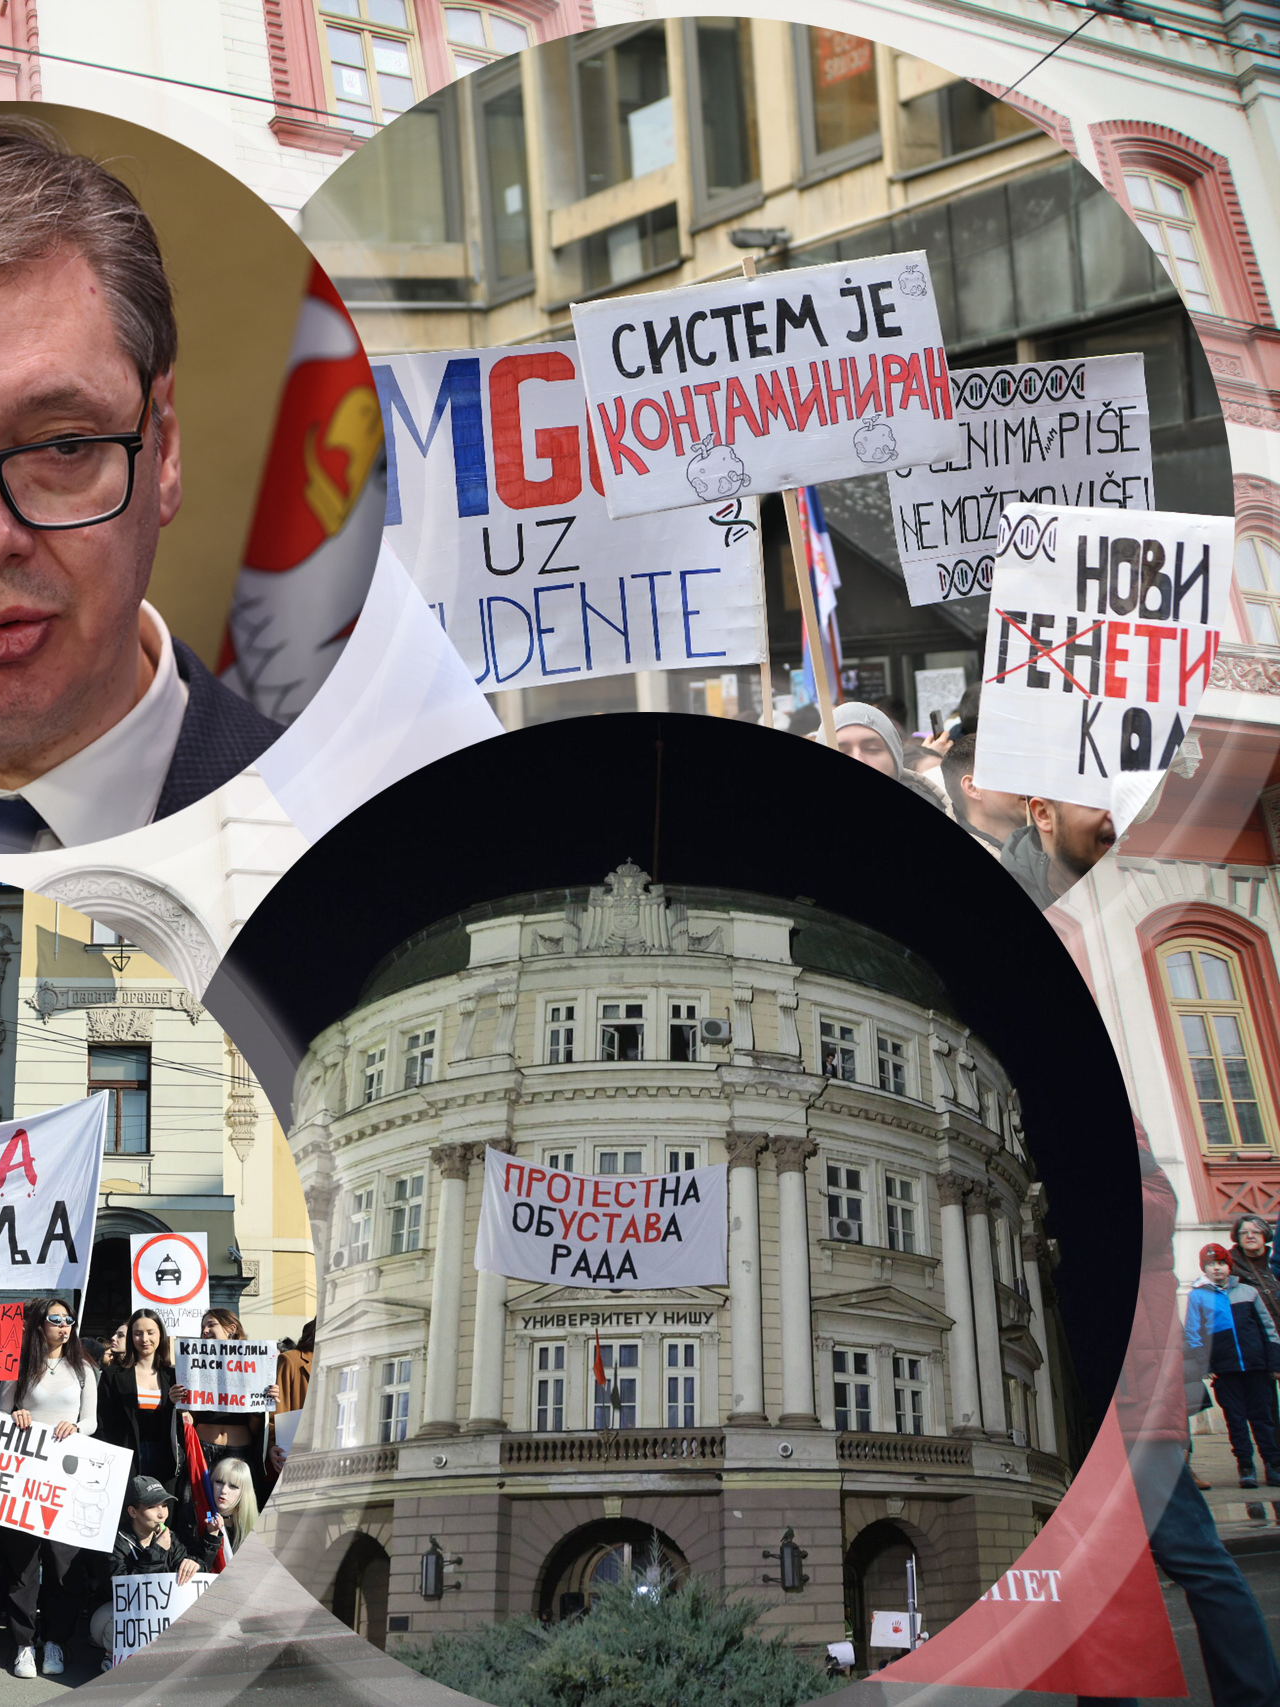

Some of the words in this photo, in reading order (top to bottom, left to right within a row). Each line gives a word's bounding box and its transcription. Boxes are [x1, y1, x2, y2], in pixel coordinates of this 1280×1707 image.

[612, 294, 829, 379] СИСТЕМ
[840, 278, 902, 342] ЈЕ
[597, 347, 952, 475] КОНТАМИНИРАН
[1059, 401, 1140, 458] PIŠE
[483, 516, 580, 575] UZ
[900, 501, 938, 552] NE
[1077, 535, 1210, 624] НОВИ
[995, 609, 1220, 707] ГЕНЕТИ
[504, 1163, 700, 1208] ПРОТЕСТНА
[512, 1202, 682, 1243] ОБУСТАВА
[550, 1244, 638, 1283] РАДА
[521, 1312, 640, 1329] УНИВЕРЗИТЕТ
[643, 1312, 658, 1326] У
[663, 1312, 714, 1326] НИШУ
[180, 1342, 217, 1356] КАДА
[220, 1344, 268, 1356] МИСЛИШ
[191, 1359, 207, 1369] ДА
[209, 1360, 222, 1369] СИ
[226, 1360, 256, 1373] САМ
[181, 1390, 214, 1404] ИМА
[218, 1393, 246, 1406] НАС
[22, 1478, 67, 1508] NIJE
[114, 1581, 172, 1612] БИЋУ
